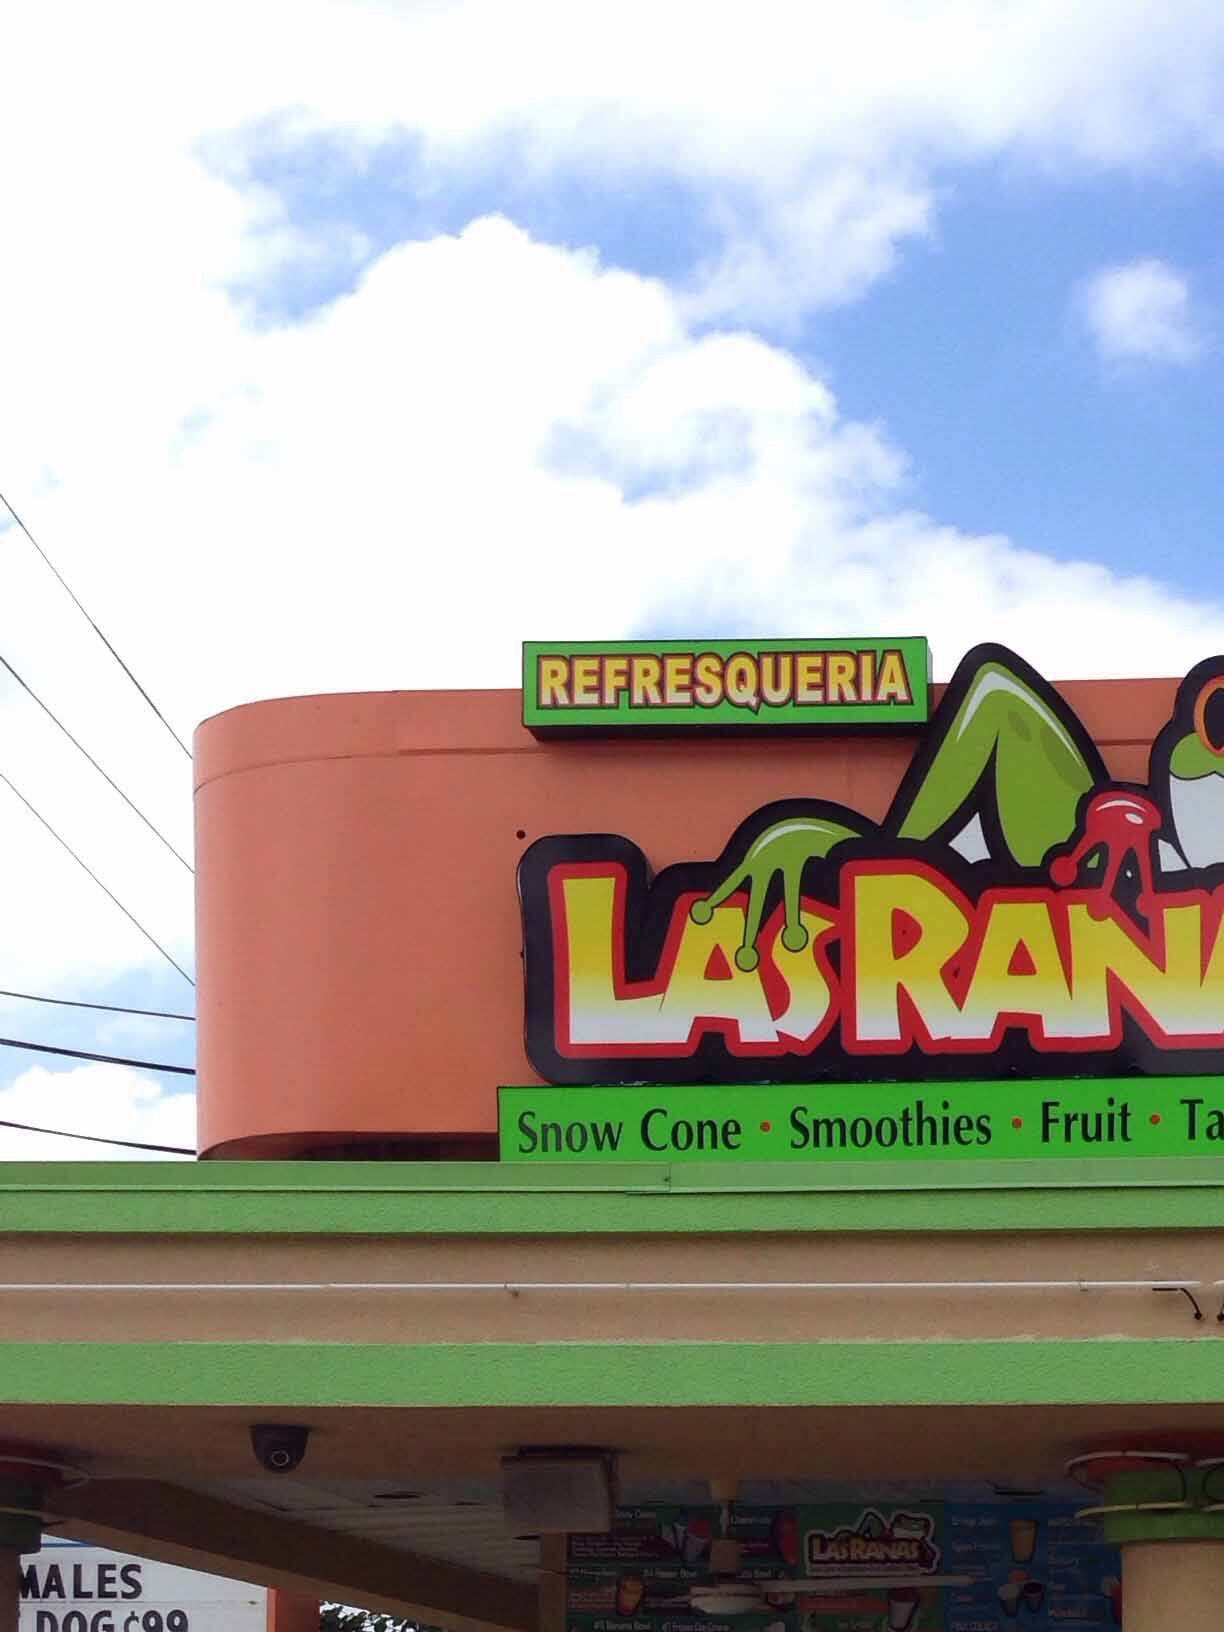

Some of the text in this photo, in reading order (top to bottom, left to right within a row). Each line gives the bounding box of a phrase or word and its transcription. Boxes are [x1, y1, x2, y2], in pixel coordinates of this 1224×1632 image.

[538, 648, 912, 714] REFRESQUERIA
[554, 864, 837, 1052] LAS
[517, 1110, 623, 1155] Snow
[640, 1107, 742, 1153] Cone
[789, 1096, 993, 1149] Smoothies
[1040, 1099, 1133, 1145] Fruit
